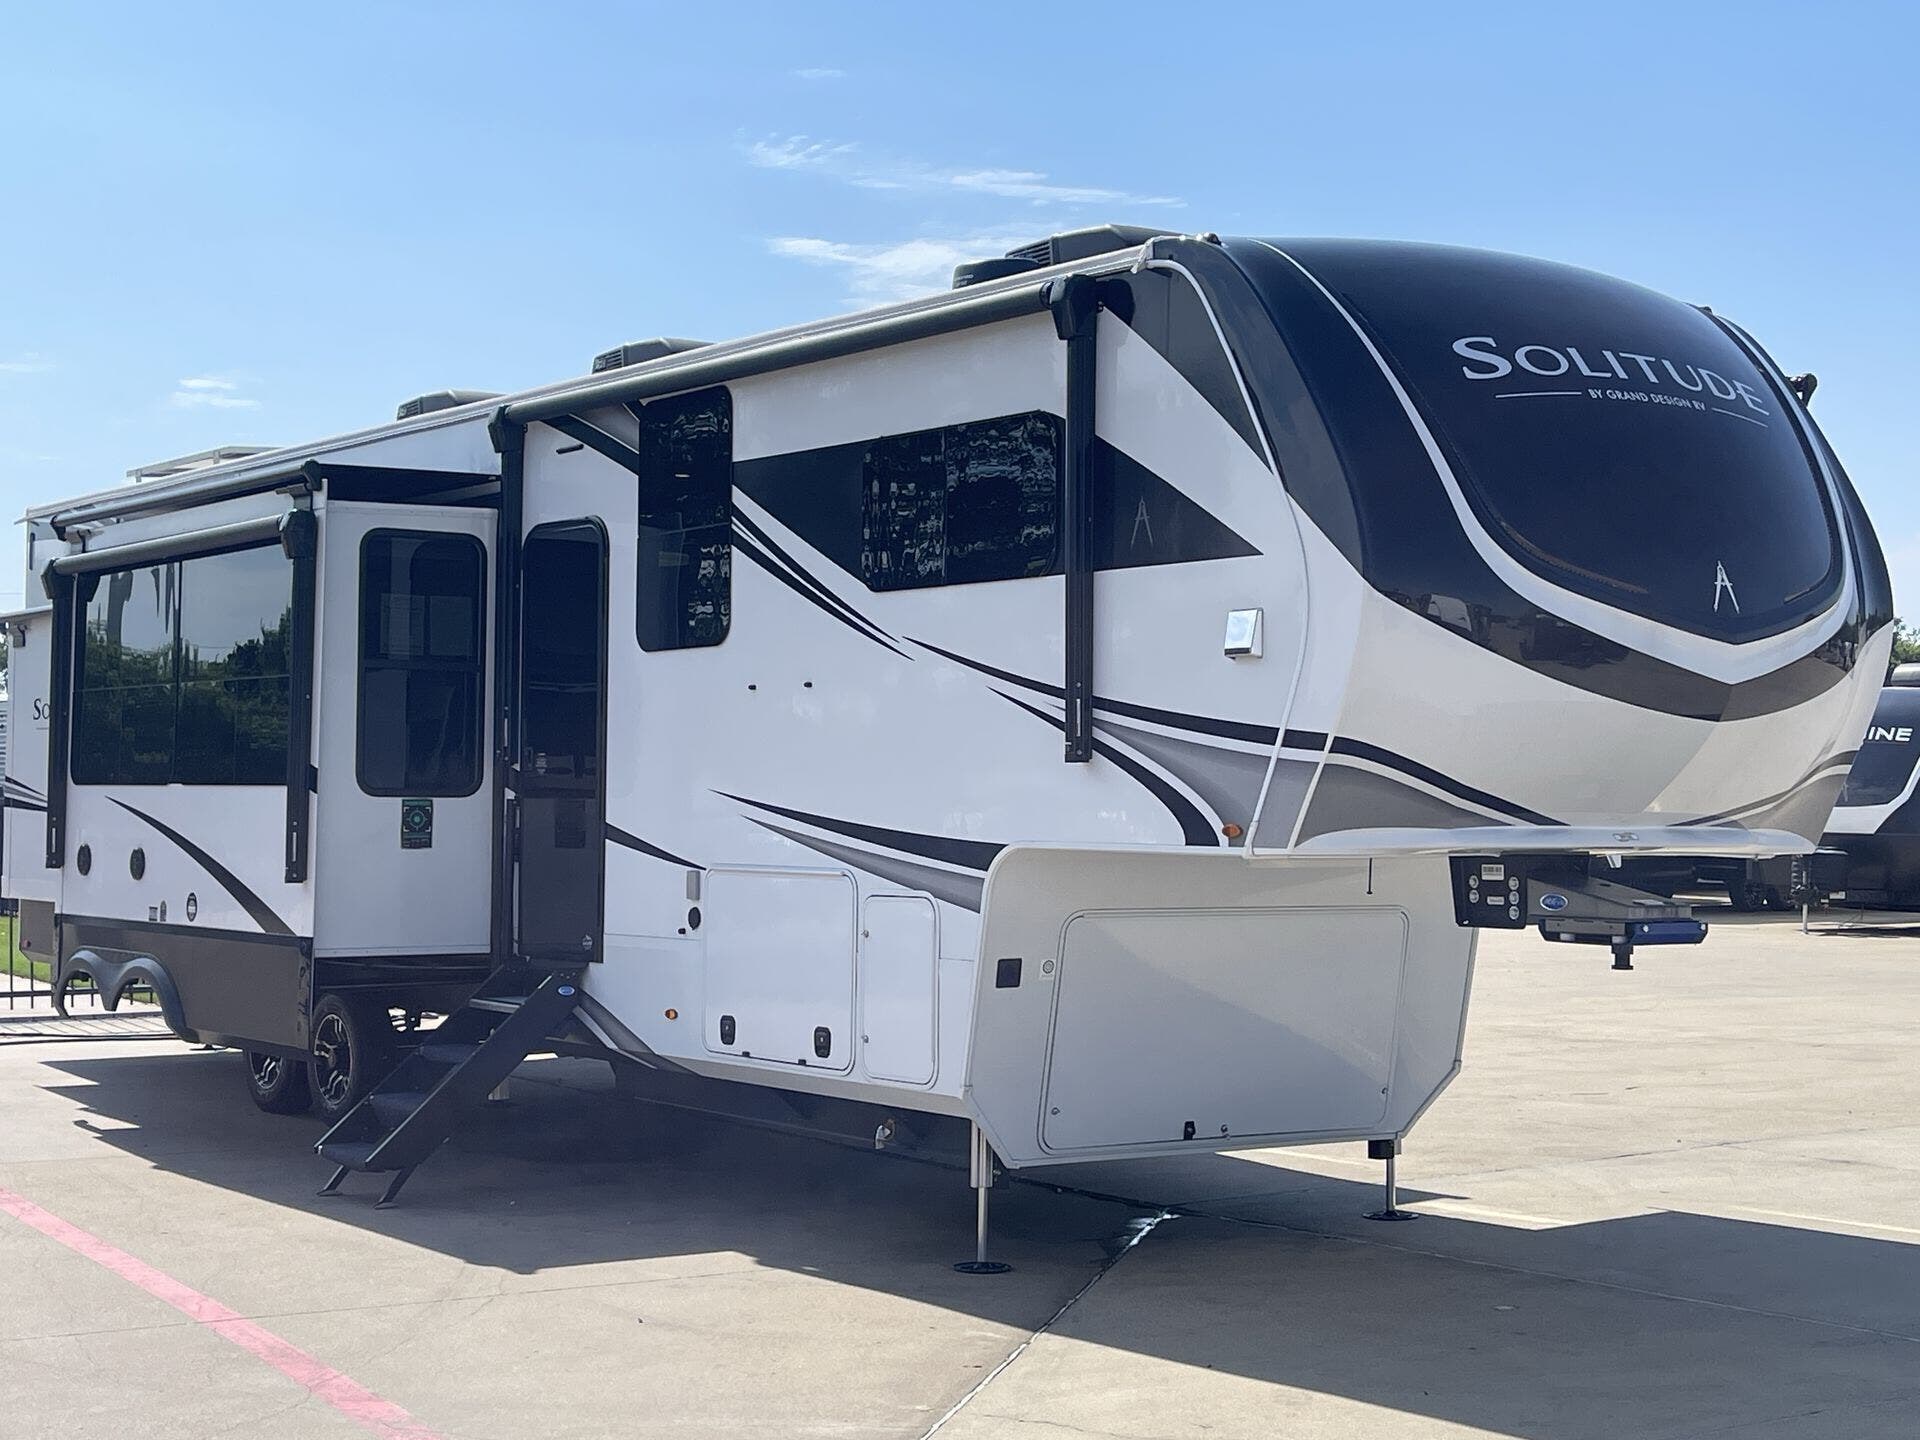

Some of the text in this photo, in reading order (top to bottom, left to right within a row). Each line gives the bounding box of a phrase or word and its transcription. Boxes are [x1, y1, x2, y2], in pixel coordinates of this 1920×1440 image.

[1452, 336, 1770, 416] SOLITUDE
[1588, 388, 1706, 411] BY GRAND DESIGN RV
